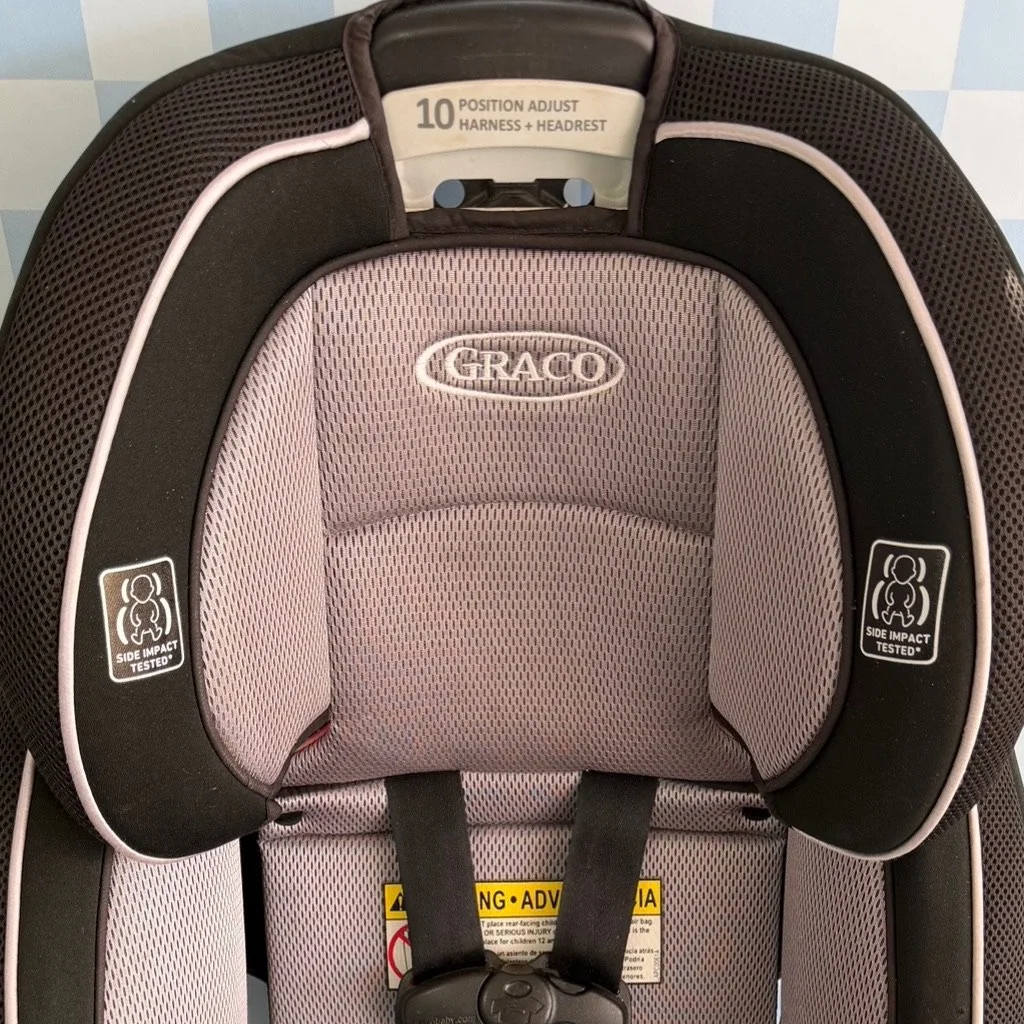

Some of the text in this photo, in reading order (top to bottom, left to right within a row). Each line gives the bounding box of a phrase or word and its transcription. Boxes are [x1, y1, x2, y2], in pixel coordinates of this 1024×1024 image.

[416, 98, 455, 130] 10
[459, 99, 579, 113] POSITION ADJUST
[459, 119, 521, 131] HARNESS
[537, 120, 607, 132] HEADREST
[445, 347, 606, 382] GRACO
[866, 626, 931, 645] SIDE IMPACT
[115, 640, 178, 663] SIDE IMPACT
